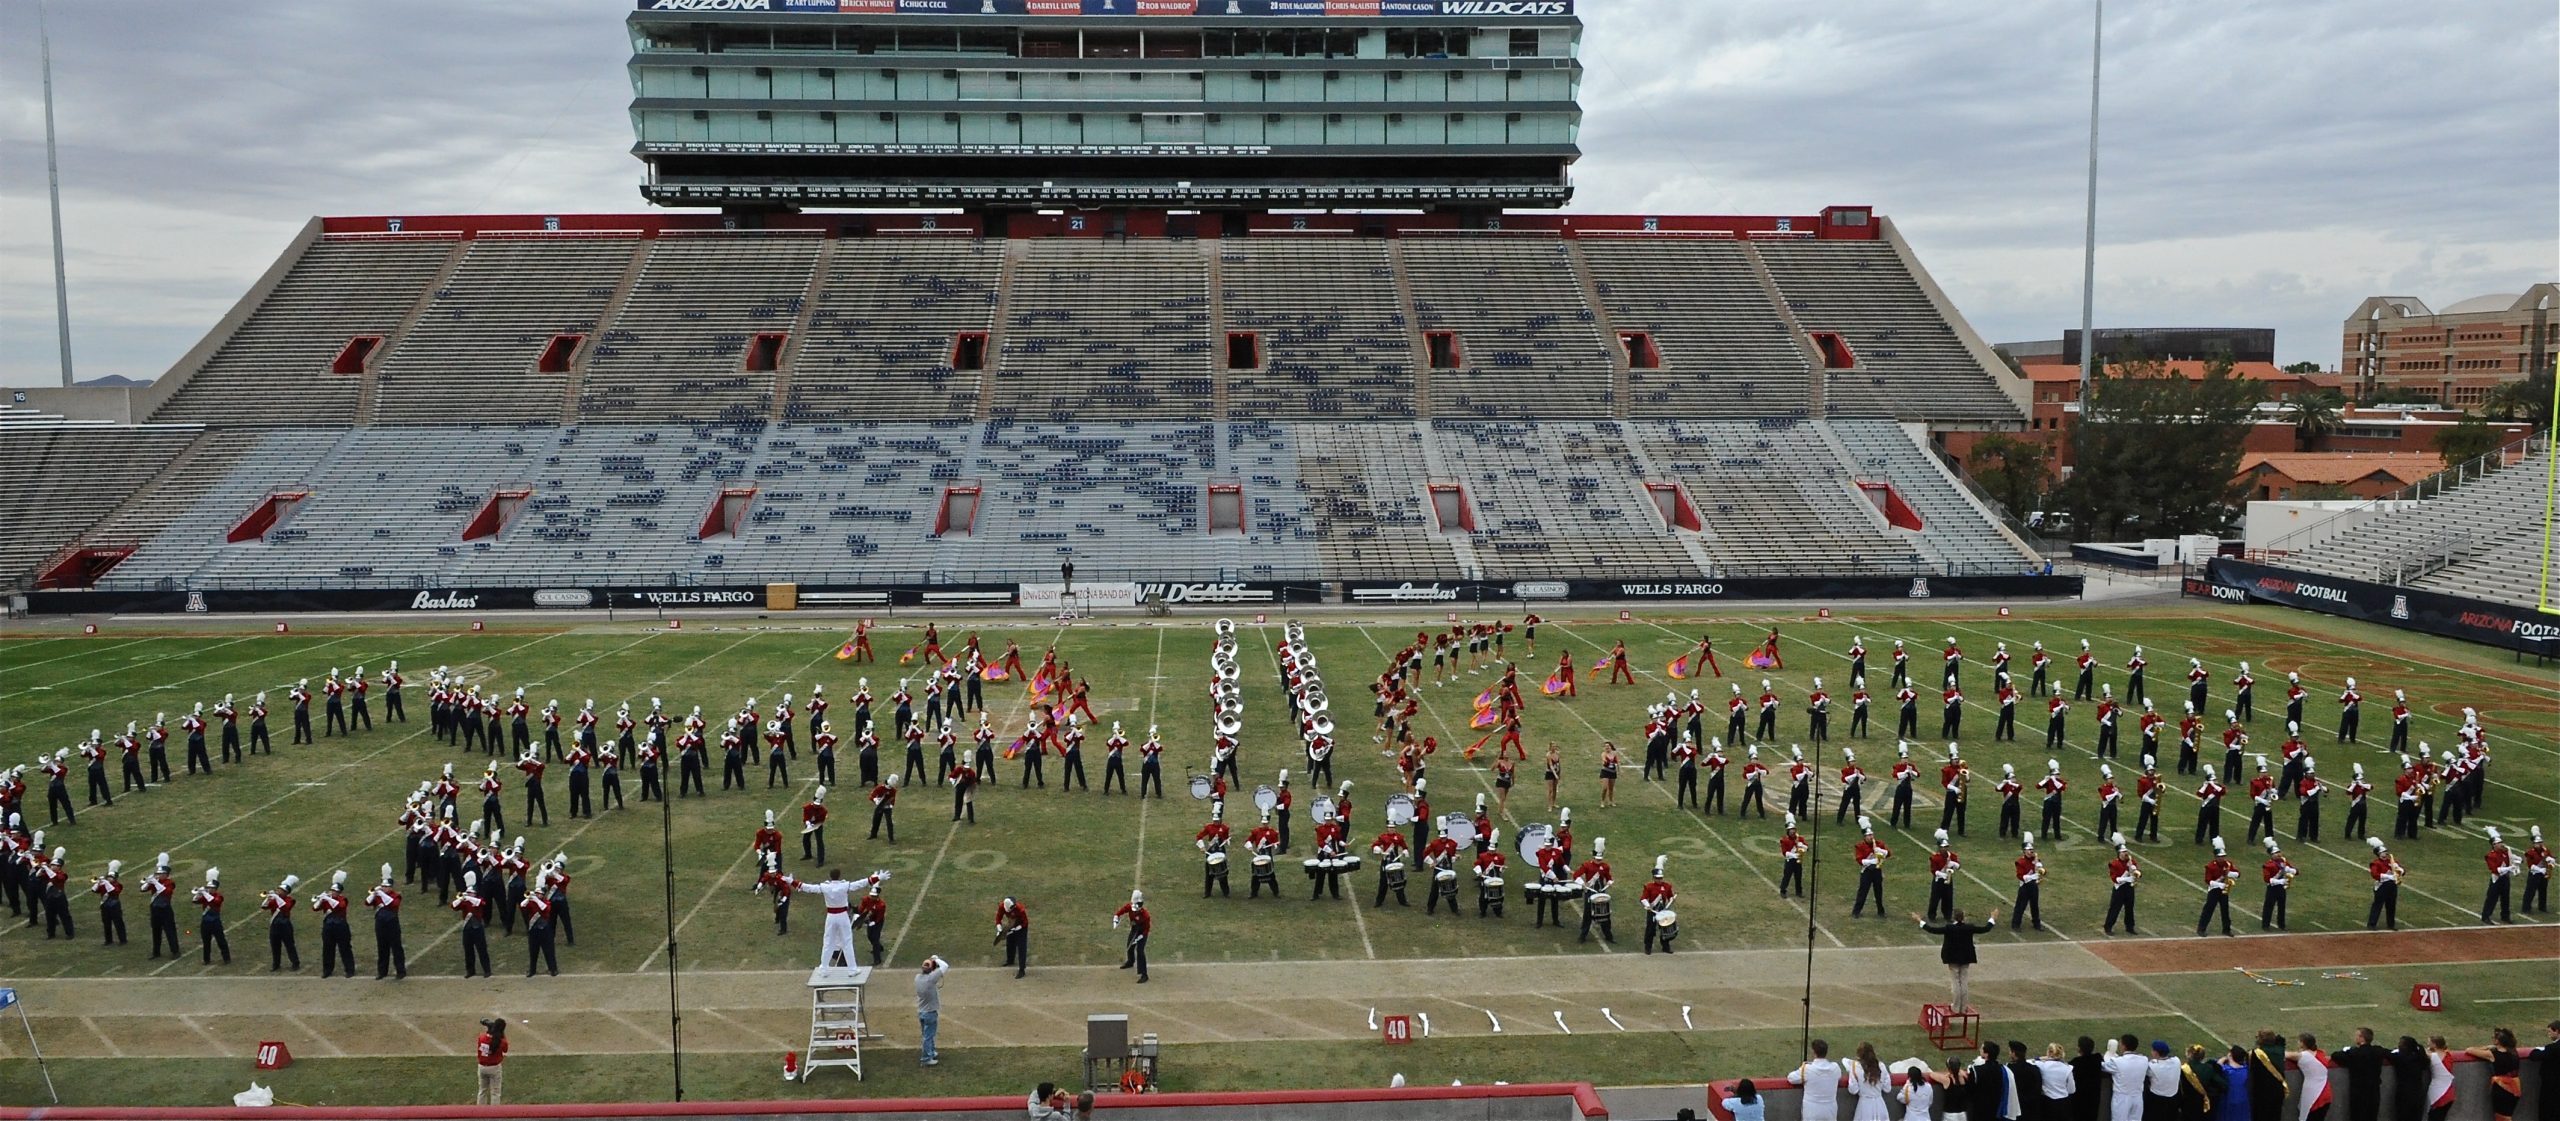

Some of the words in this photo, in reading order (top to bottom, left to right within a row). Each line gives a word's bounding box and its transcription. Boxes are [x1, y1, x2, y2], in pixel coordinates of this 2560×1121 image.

[650, 0, 770, 10] ARIZONA
[905, 0, 928, 8] CHUCK
[1032, 1, 1060, 9] DARRYLL
[1412, 3, 1433, 11] CASON
[1442, 2, 1566, 14] WILDCATS
[390, 222, 400, 232] 17
[546, 221, 558, 231] 18
[724, 220, 735, 230] 19
[922, 219, 936, 229] 20
[1071, 220, 1083, 229] 21
[1293, 220, 1306, 229] 22
[1487, 220, 1500, 230] 23
[1644, 222, 1657, 231] 24
[1777, 222, 1790, 232] 25
[15, 392, 26, 402] 16
[1621, 584, 1671, 595] WELLS
[1674, 584, 1723, 595] FARGO
[2186, 581, 2211, 593] BEAR
[2212, 585, 2245, 601] DOWN
[2295, 583, 2348, 603] FOOTBALL
[411, 591, 478, 609] Bashas'
[647, 592, 700, 603] WELLS
[703, 592, 754, 603] FARGO
[1023, 590, 1057, 600] UNIVERSITY
[1099, 590, 1117, 600] BAND
[1119, 590, 1131, 600] DAY
[2460, 612, 2512, 632] ARIZONA
[2420, 988, 2439, 1007] 20
[1388, 1020, 1406, 1039] 40
[258, 1045, 278, 1066] 40
